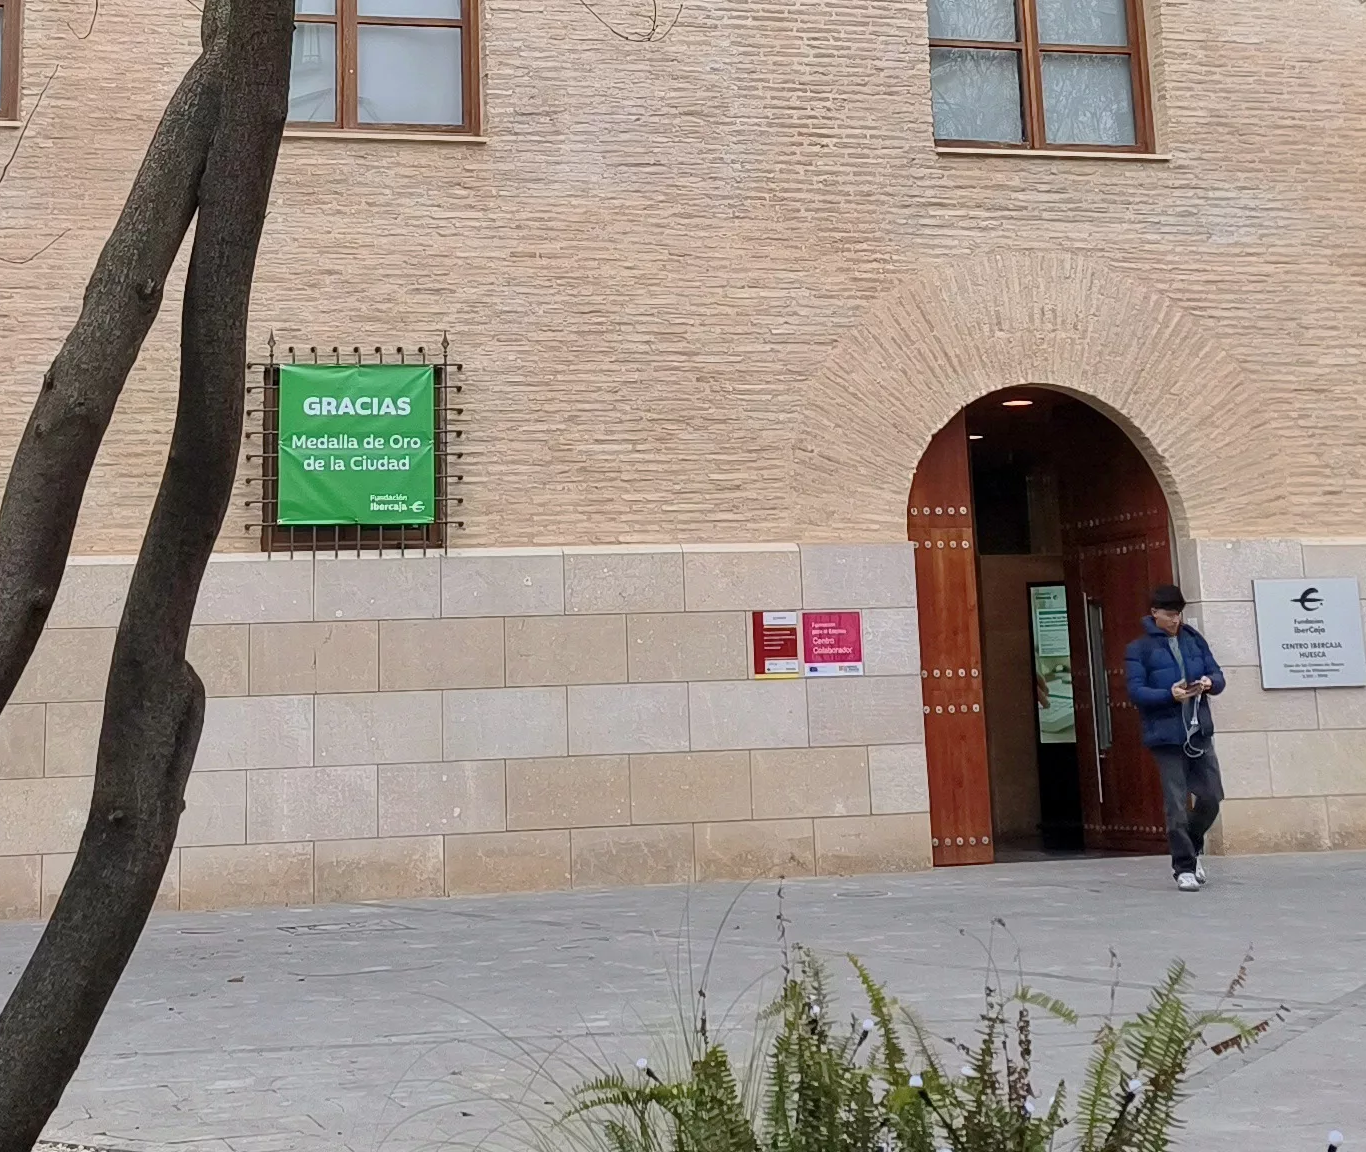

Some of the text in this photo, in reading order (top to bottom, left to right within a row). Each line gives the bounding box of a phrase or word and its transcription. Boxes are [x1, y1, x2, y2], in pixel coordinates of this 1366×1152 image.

[303, 397, 412, 416] GRACIAS
[291, 434, 421, 449] Medalla de Oro
[303, 456, 410, 471] de la Ciudad
[1299, 651, 1327, 659] HUESCA
